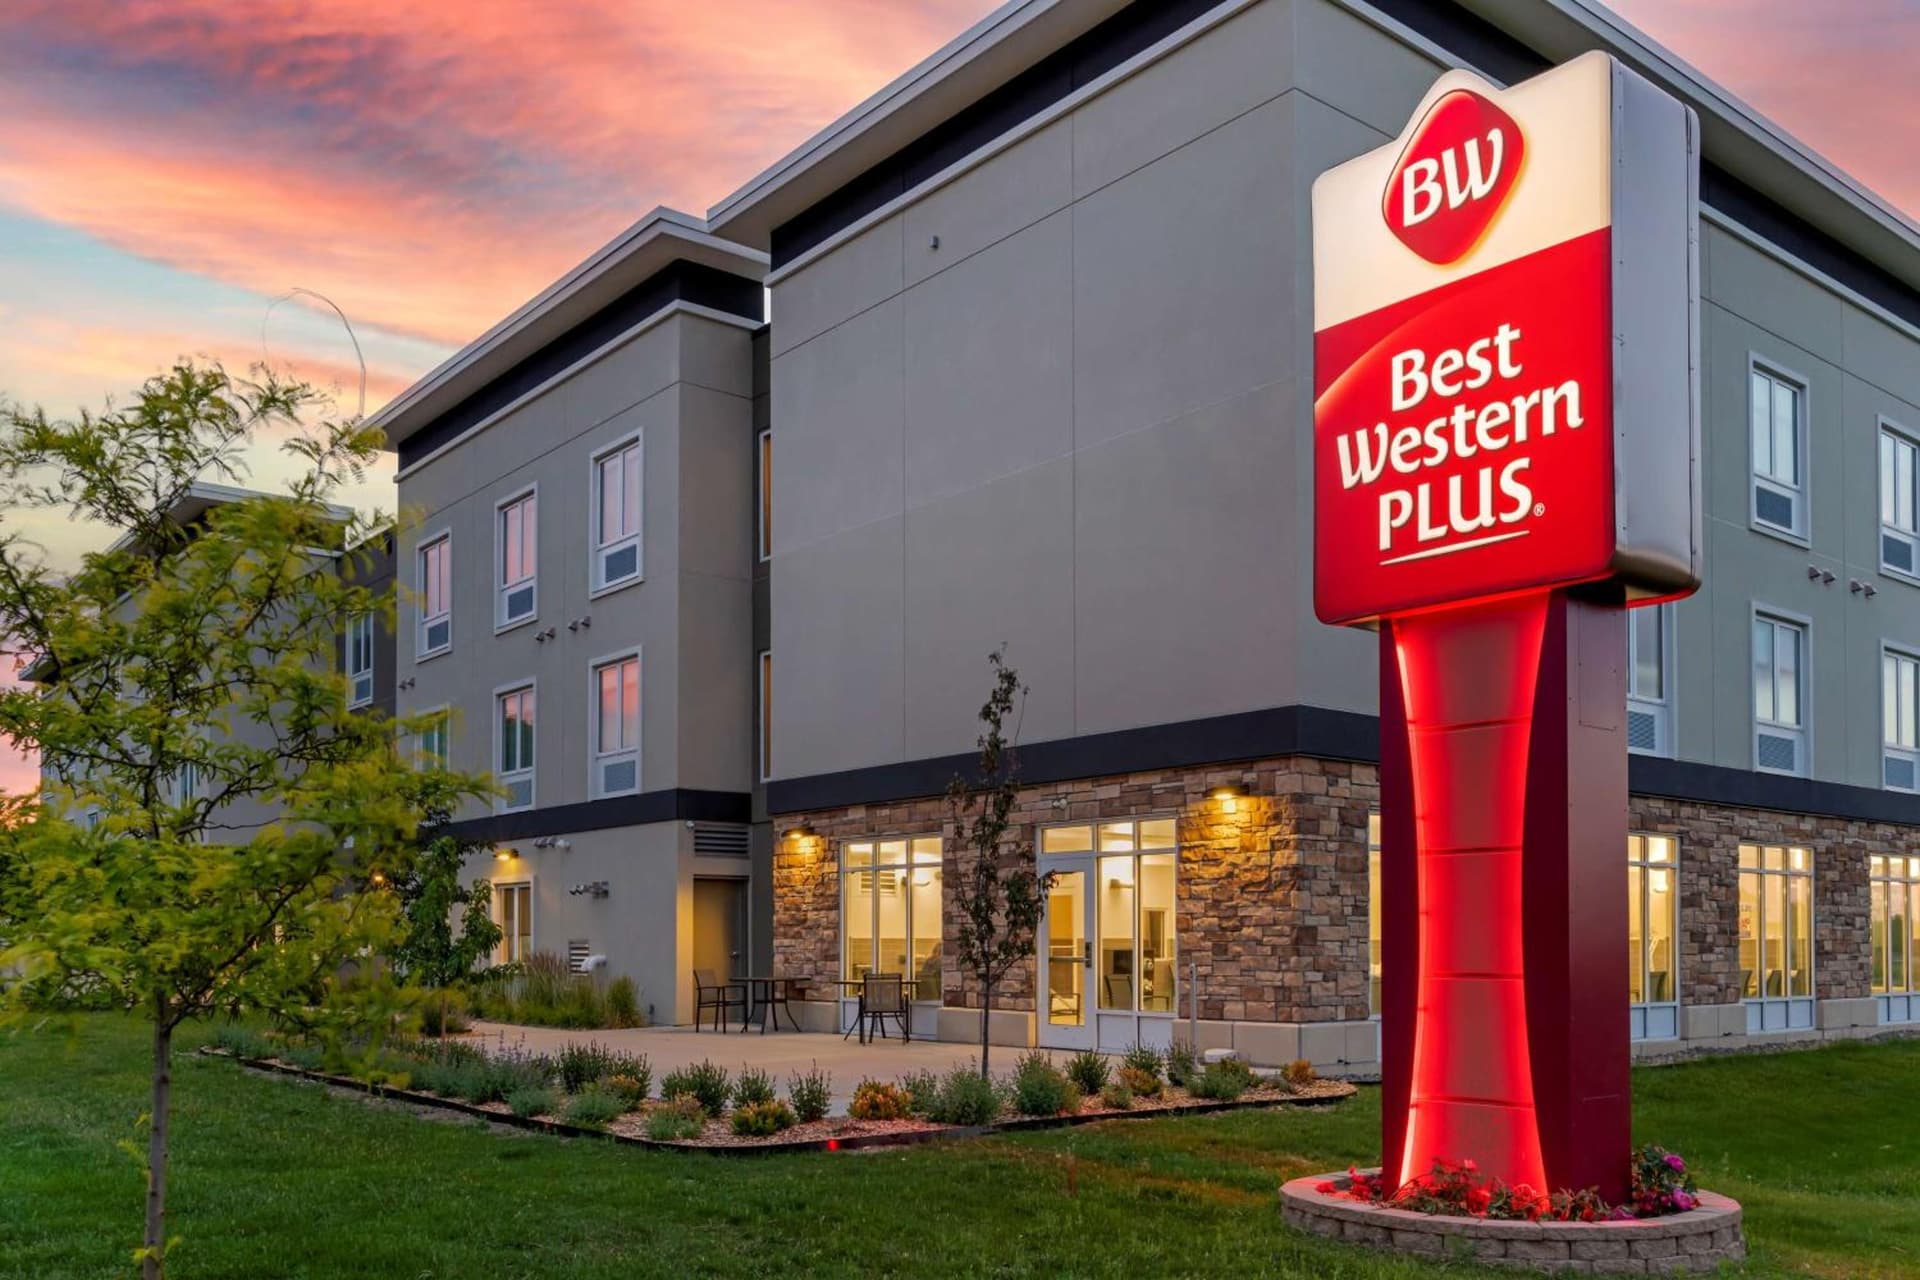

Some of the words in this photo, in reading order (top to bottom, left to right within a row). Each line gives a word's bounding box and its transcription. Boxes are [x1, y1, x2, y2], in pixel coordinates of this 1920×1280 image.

[1404, 127, 1504, 227] BW
[1391, 323, 1523, 412] Best
[1336, 380, 1584, 489] Western
